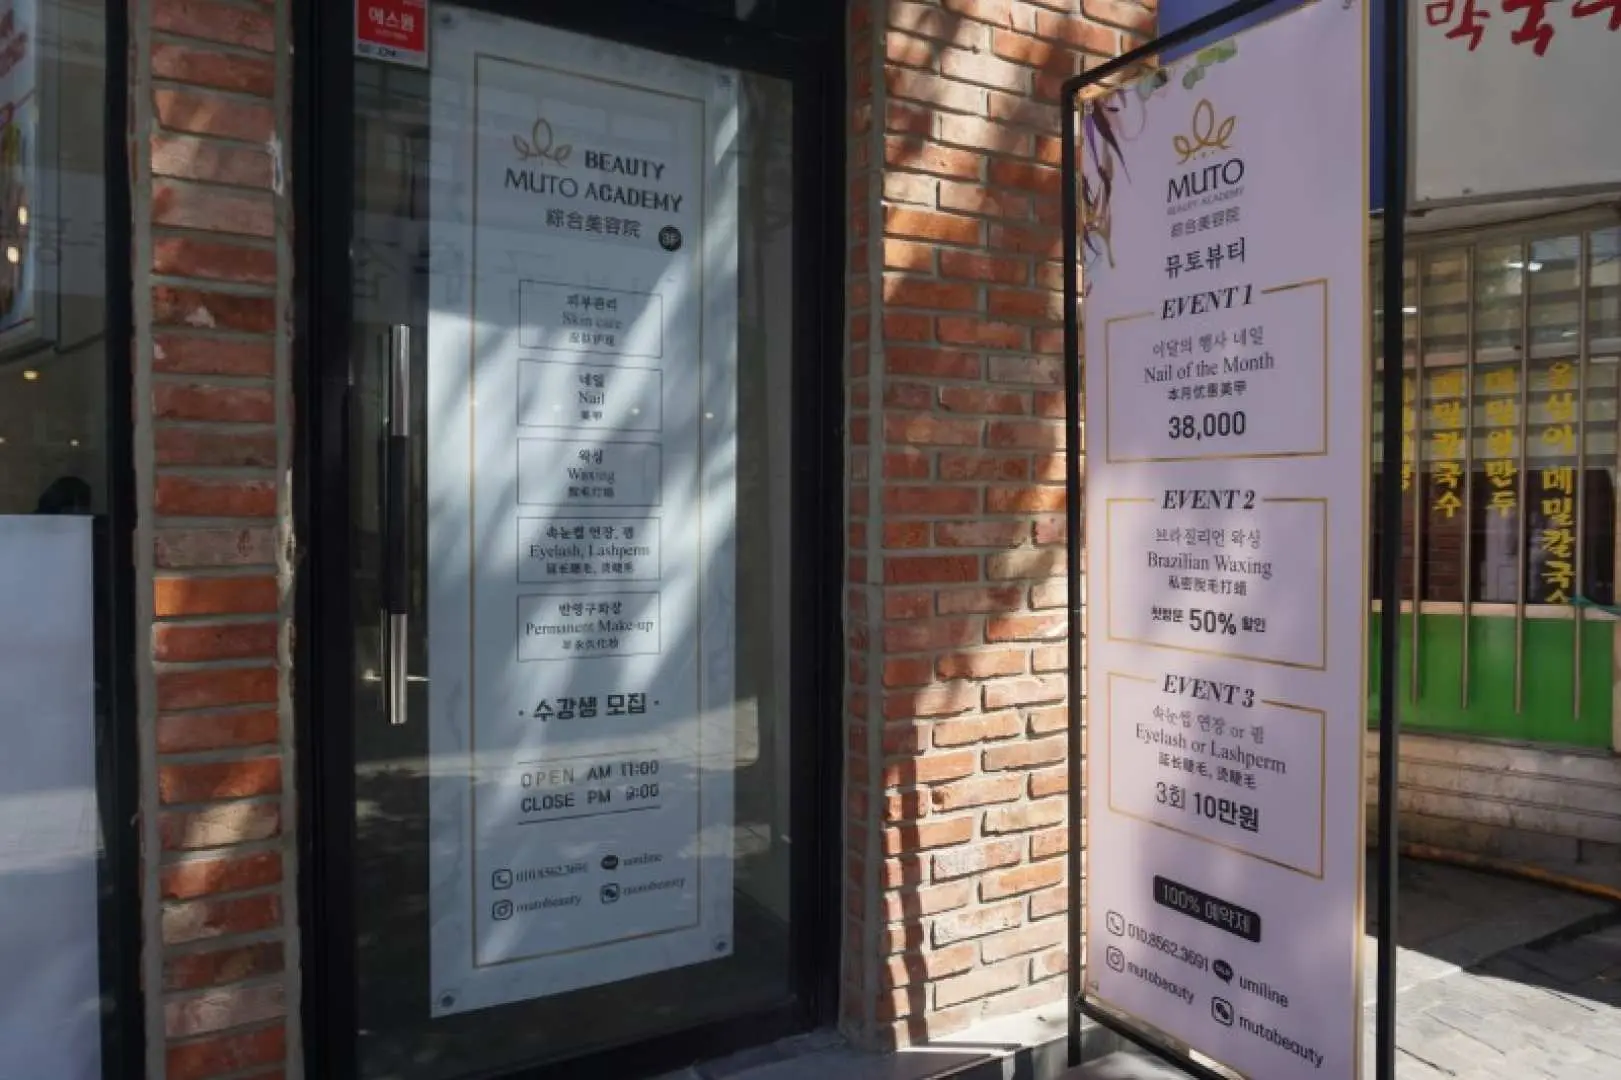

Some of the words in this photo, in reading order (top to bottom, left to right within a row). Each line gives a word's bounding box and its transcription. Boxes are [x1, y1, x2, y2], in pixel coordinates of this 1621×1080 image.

[1426, 0, 1621, 56] 막국
[585, 150, 666, 181] BEAUTY
[1166, 158, 1245, 203] MUTO
[504, 167, 579, 199] MUTO
[585, 182, 683, 213] ACADEMY
[1202, 186, 1245, 206] ACADEMY
[1165, 236, 1245, 279] 뮤토뷰티
[1161, 286, 1240, 320] EVENT
[1243, 284, 1253, 305] 1
[1152, 335, 1193, 358] 이달의
[1199, 330, 1227, 353] 행사
[1233, 325, 1264, 346] 네일
[1143, 364, 1172, 383] Nail
[1176, 361, 1194, 380] of
[1196, 359, 1218, 377] the
[1223, 351, 1275, 374] Month
[579, 391, 605, 405] Nail
[1168, 411, 1246, 440] 38,000
[567, 467, 615, 485] Waxing
[1162, 489, 1241, 510] EVENT
[1243, 489, 1257, 510] 2
[1156, 527, 1226, 547] 브라질리언
[1231, 528, 1261, 549] 왁싱
[1147, 550, 1210, 571] Brazilian
[1213, 553, 1274, 581] Waxing
[1189, 609, 1237, 636] 50%
[1242, 614, 1267, 634] 할인
[606, 693, 647, 716] 모집
[1162, 673, 1241, 706] EVENT
[1241, 688, 1256, 708] 3
[1152, 705, 1193, 729] 속눈썹
[1197, 713, 1226, 736] 연장
[1230, 726, 1246, 739] or
[1136, 722, 1188, 750] Eyelash
[1191, 739, 1207, 753] or
[1210, 739, 1288, 776] Lashperm
[521, 769, 575, 788] OPEN
[587, 765, 612, 781] AM
[621, 760, 660, 777] 11:00
[521, 792, 575, 813] CLOSE
[587, 788, 611, 805] PM
[625, 783, 660, 801] 9:00
[1156, 781, 1187, 811] 3회
[1193, 791, 1260, 834] 10만원
[1163, 883, 1201, 914] 100%
[1204, 900, 1253, 935] 예약제
[1127, 960, 1195, 1006] mutobeauty
[1238, 974, 1290, 1008] umiline
[1239, 1014, 1325, 1069] mutobeauty
